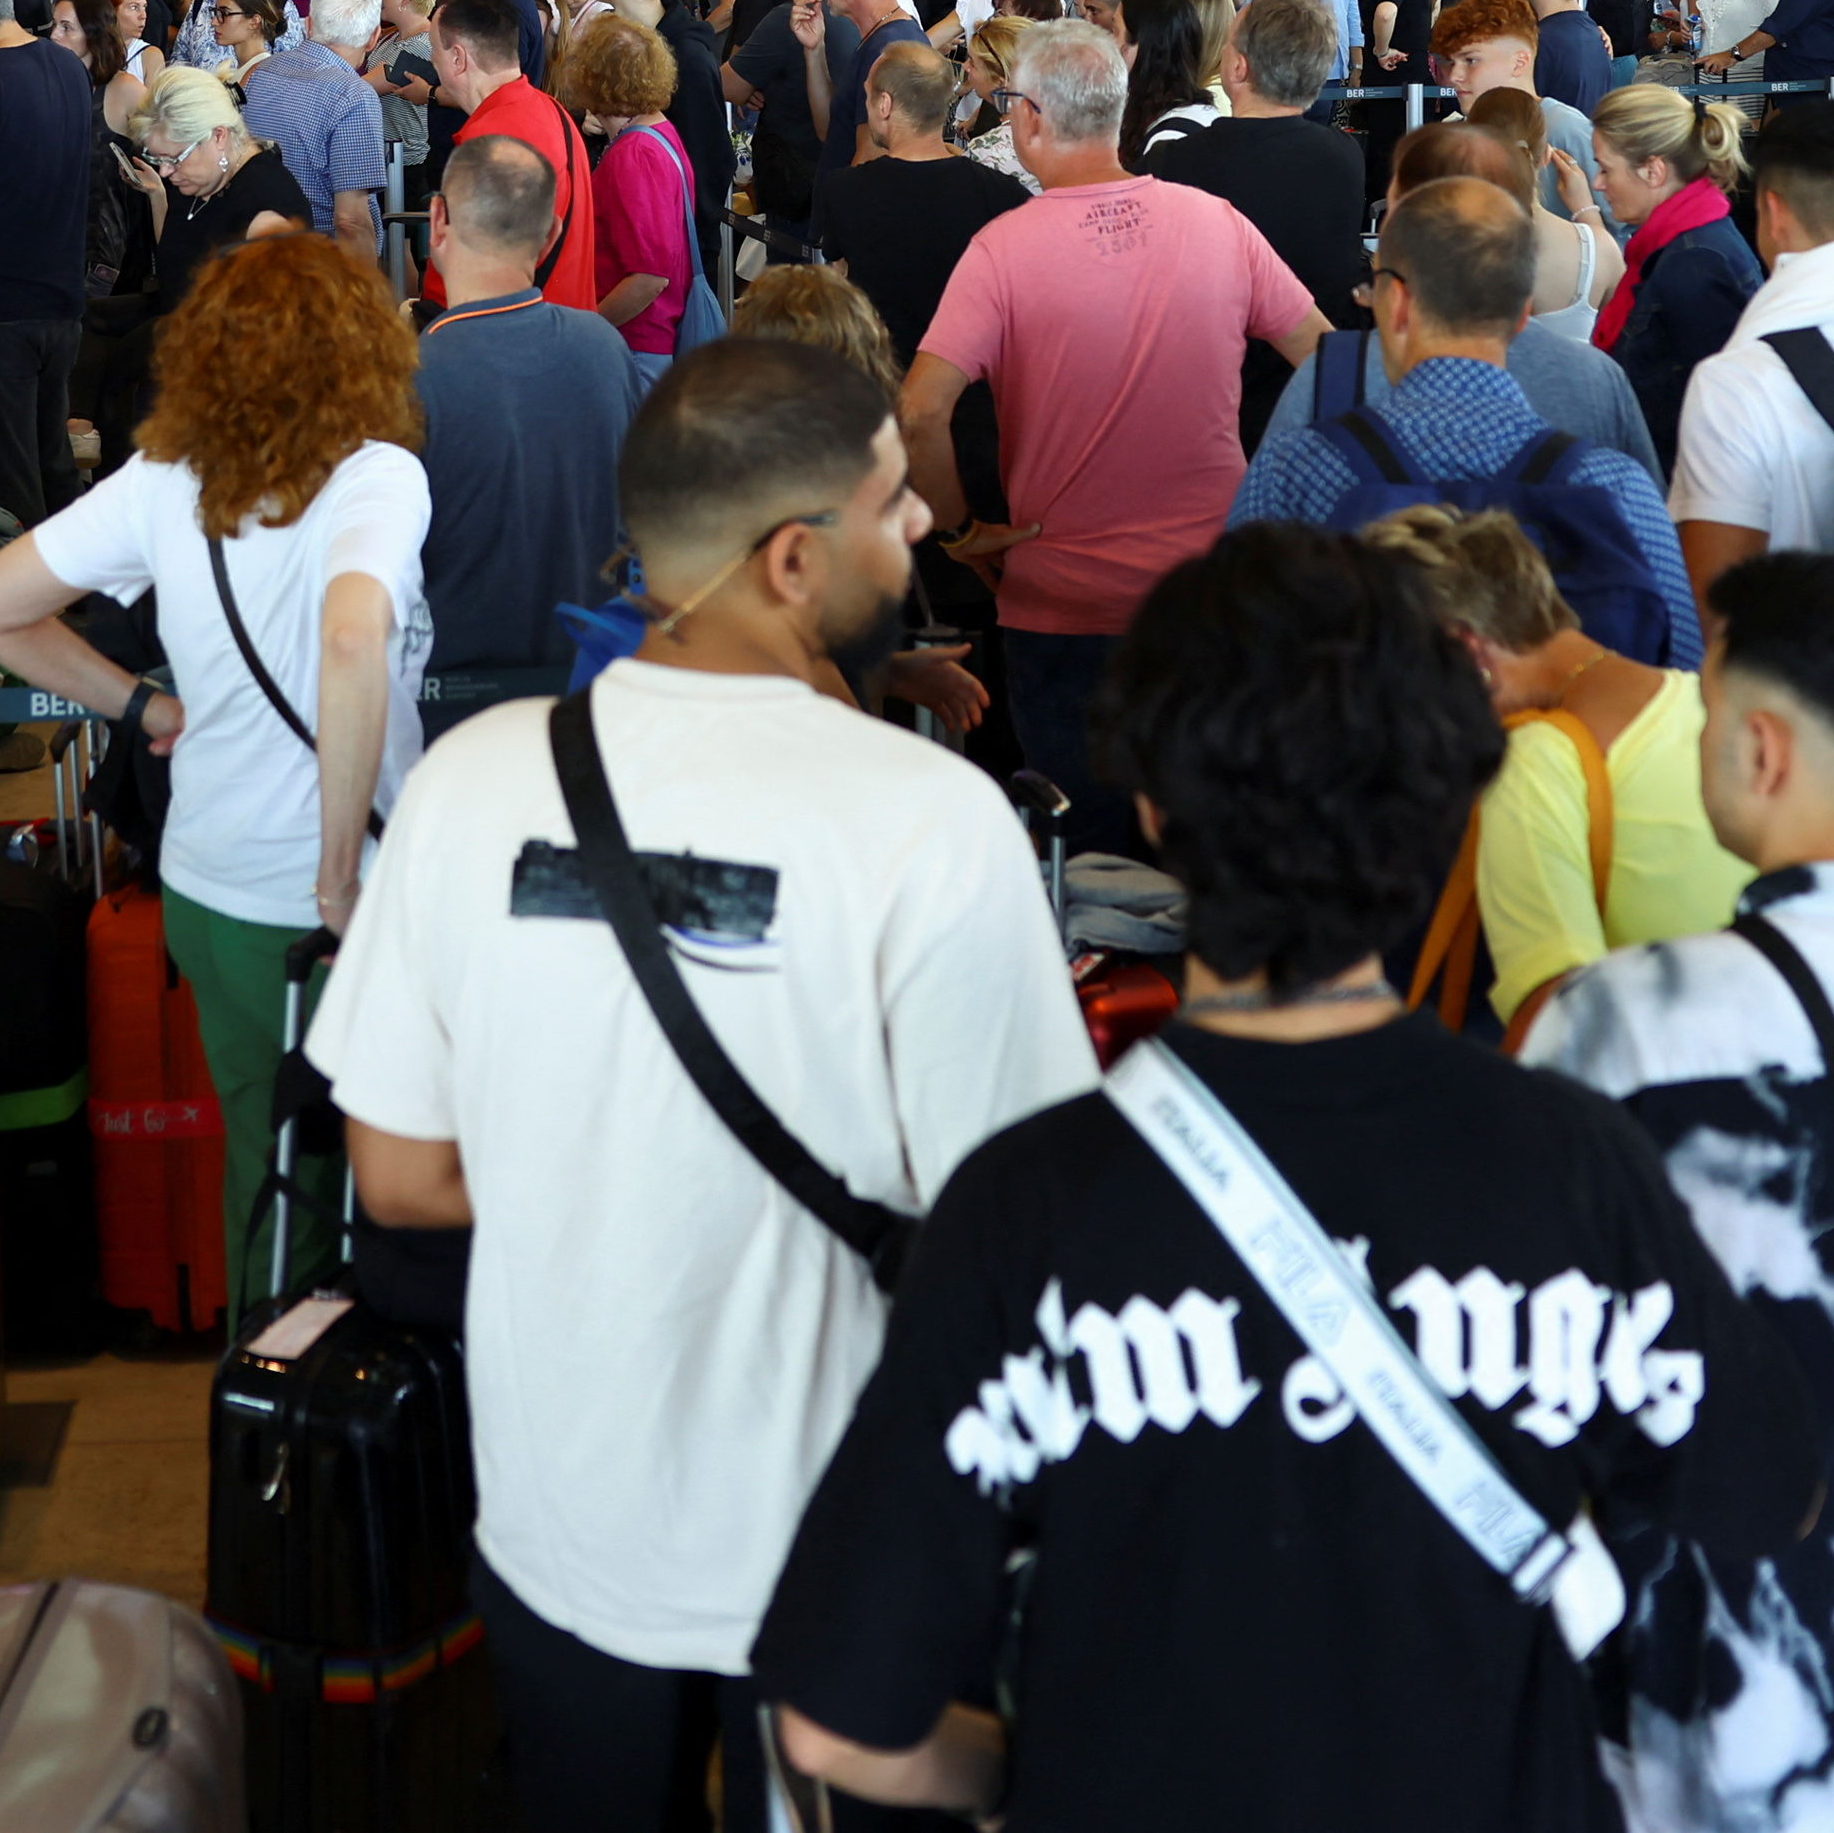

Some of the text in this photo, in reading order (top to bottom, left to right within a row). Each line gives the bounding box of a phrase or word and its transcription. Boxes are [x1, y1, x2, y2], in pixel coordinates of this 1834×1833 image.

[1771, 82, 1789, 92] BER
[1346, 89, 1364, 98] BER
[1251, 1216, 1354, 1350] FILA
